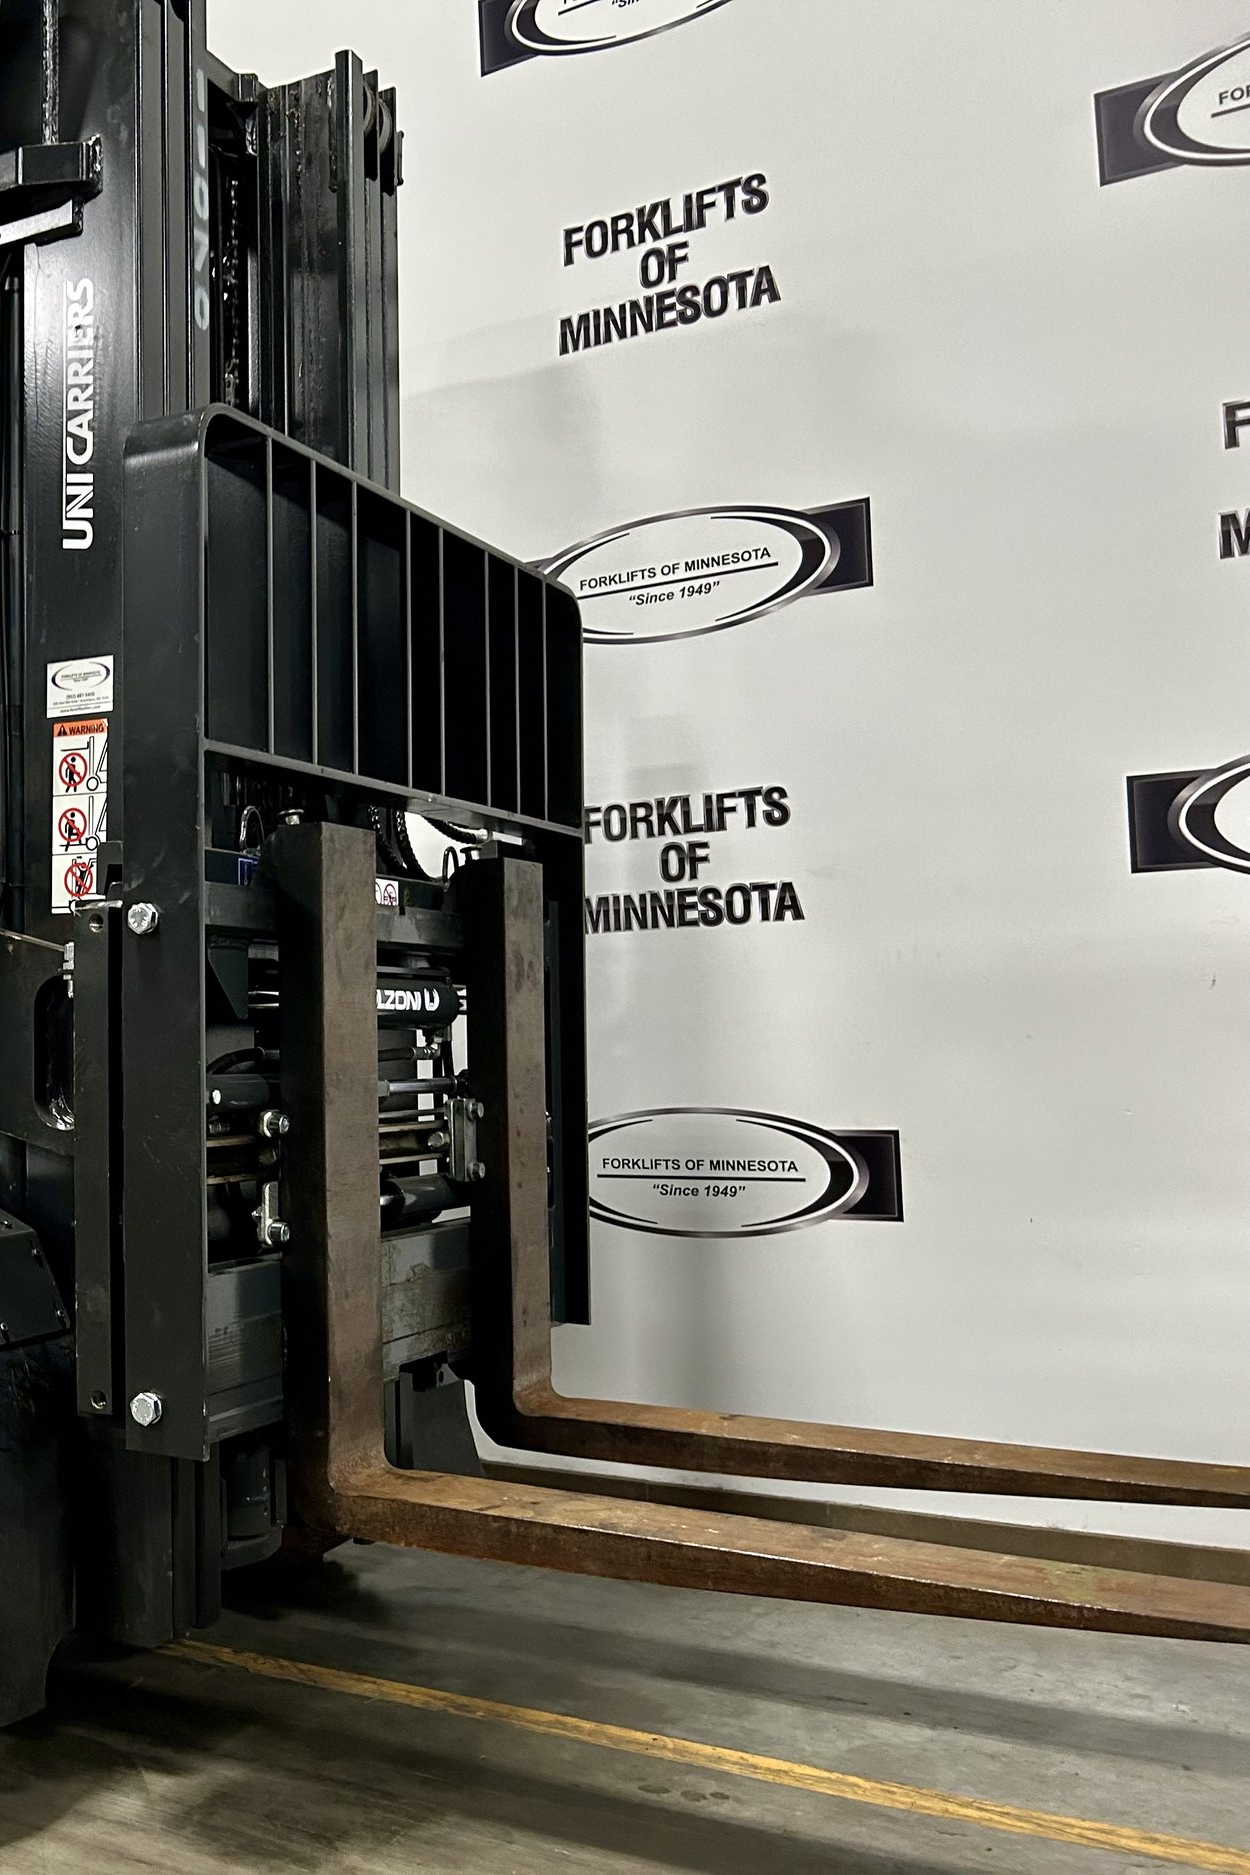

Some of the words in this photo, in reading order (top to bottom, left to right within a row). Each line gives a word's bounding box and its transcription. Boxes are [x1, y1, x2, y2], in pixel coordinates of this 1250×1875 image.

[563, 173, 770, 267] FORKLIFTS
[639, 241, 689, 289] OF
[559, 265, 781, 356] MINNESOTA
[579, 567, 657, 591] FORKLIFTS
[660, 563, 680, 576] OF
[684, 547, 771, 572] MINNESOTA
[69, 723, 105, 735] WARNING
[584, 786, 791, 844] FORKLIFTS
[660, 841, 710, 883] OF
[585, 881, 805, 934] MINNESOTA
[377, 989, 421, 1012] LZONI
[602, 1158, 681, 1171] FORKLIFTS
[684, 1159, 705, 1171] OF
[709, 1159, 799, 1173] MINNESOTA
